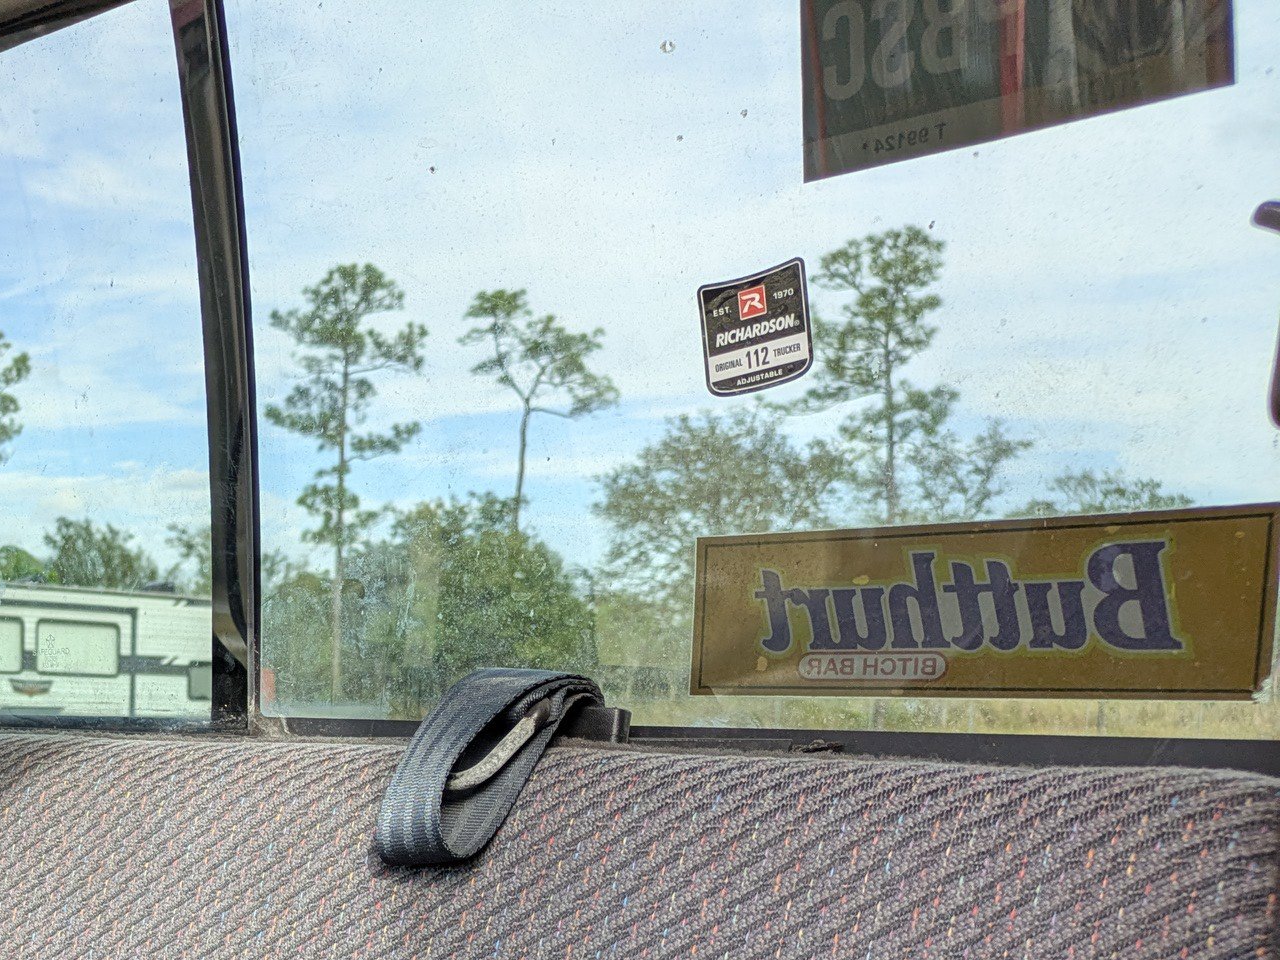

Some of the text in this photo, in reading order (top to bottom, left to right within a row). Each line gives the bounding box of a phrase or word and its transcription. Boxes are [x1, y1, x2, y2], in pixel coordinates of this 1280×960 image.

[713, 288, 794, 318] EST. 1970
[715, 343, 801, 373] ORIGINAL 112 TRUCKER
[736, 368, 783, 386] ADJUSTABLE
